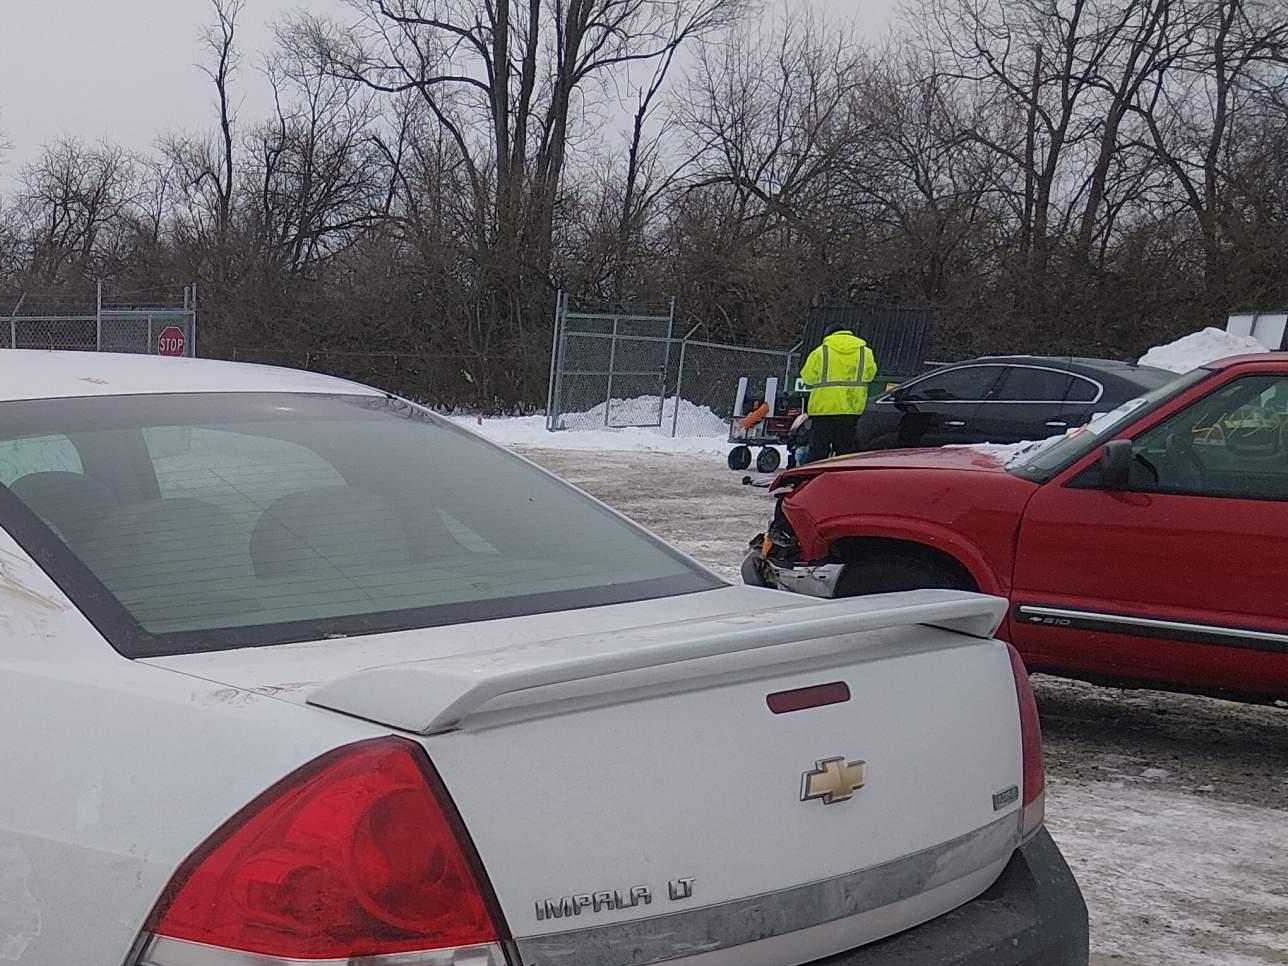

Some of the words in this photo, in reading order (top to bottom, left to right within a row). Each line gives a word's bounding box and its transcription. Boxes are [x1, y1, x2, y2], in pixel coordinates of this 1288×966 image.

[159, 338, 183, 352] STOP
[535, 885, 652, 921] IMPALA
[668, 877, 695, 901] LT
